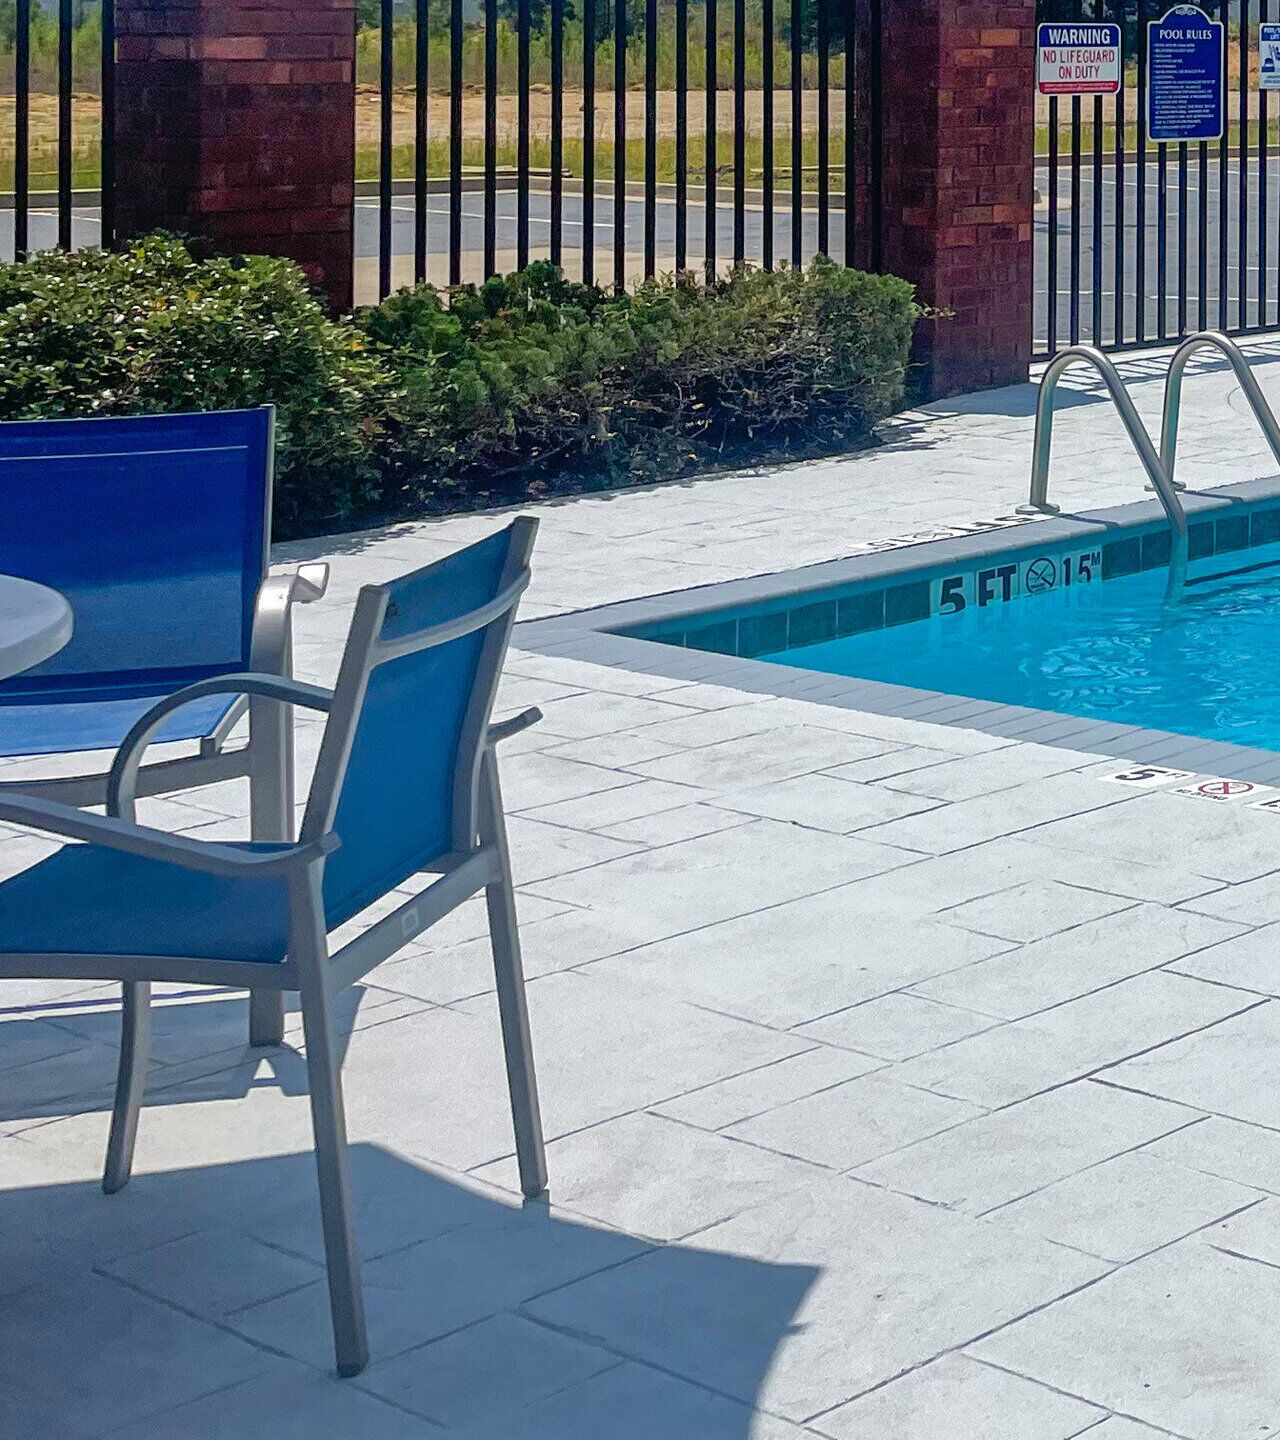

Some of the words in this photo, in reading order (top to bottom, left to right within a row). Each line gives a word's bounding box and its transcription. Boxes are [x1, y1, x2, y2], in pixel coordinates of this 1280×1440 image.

[1048, 28, 1111, 45] WARNING
[1159, 29, 1184, 40] POOL
[1186, 29, 1213, 40] RULES
[1043, 50, 1057, 63] NO
[1060, 49, 1115, 63] LIFEGUARD
[1058, 65, 1072, 79] ON
[1075, 65, 1101, 79] DUTY
[939, 576, 967, 616] 5
[978, 564, 1017, 607] FT
[1115, 768, 1168, 781] 5
